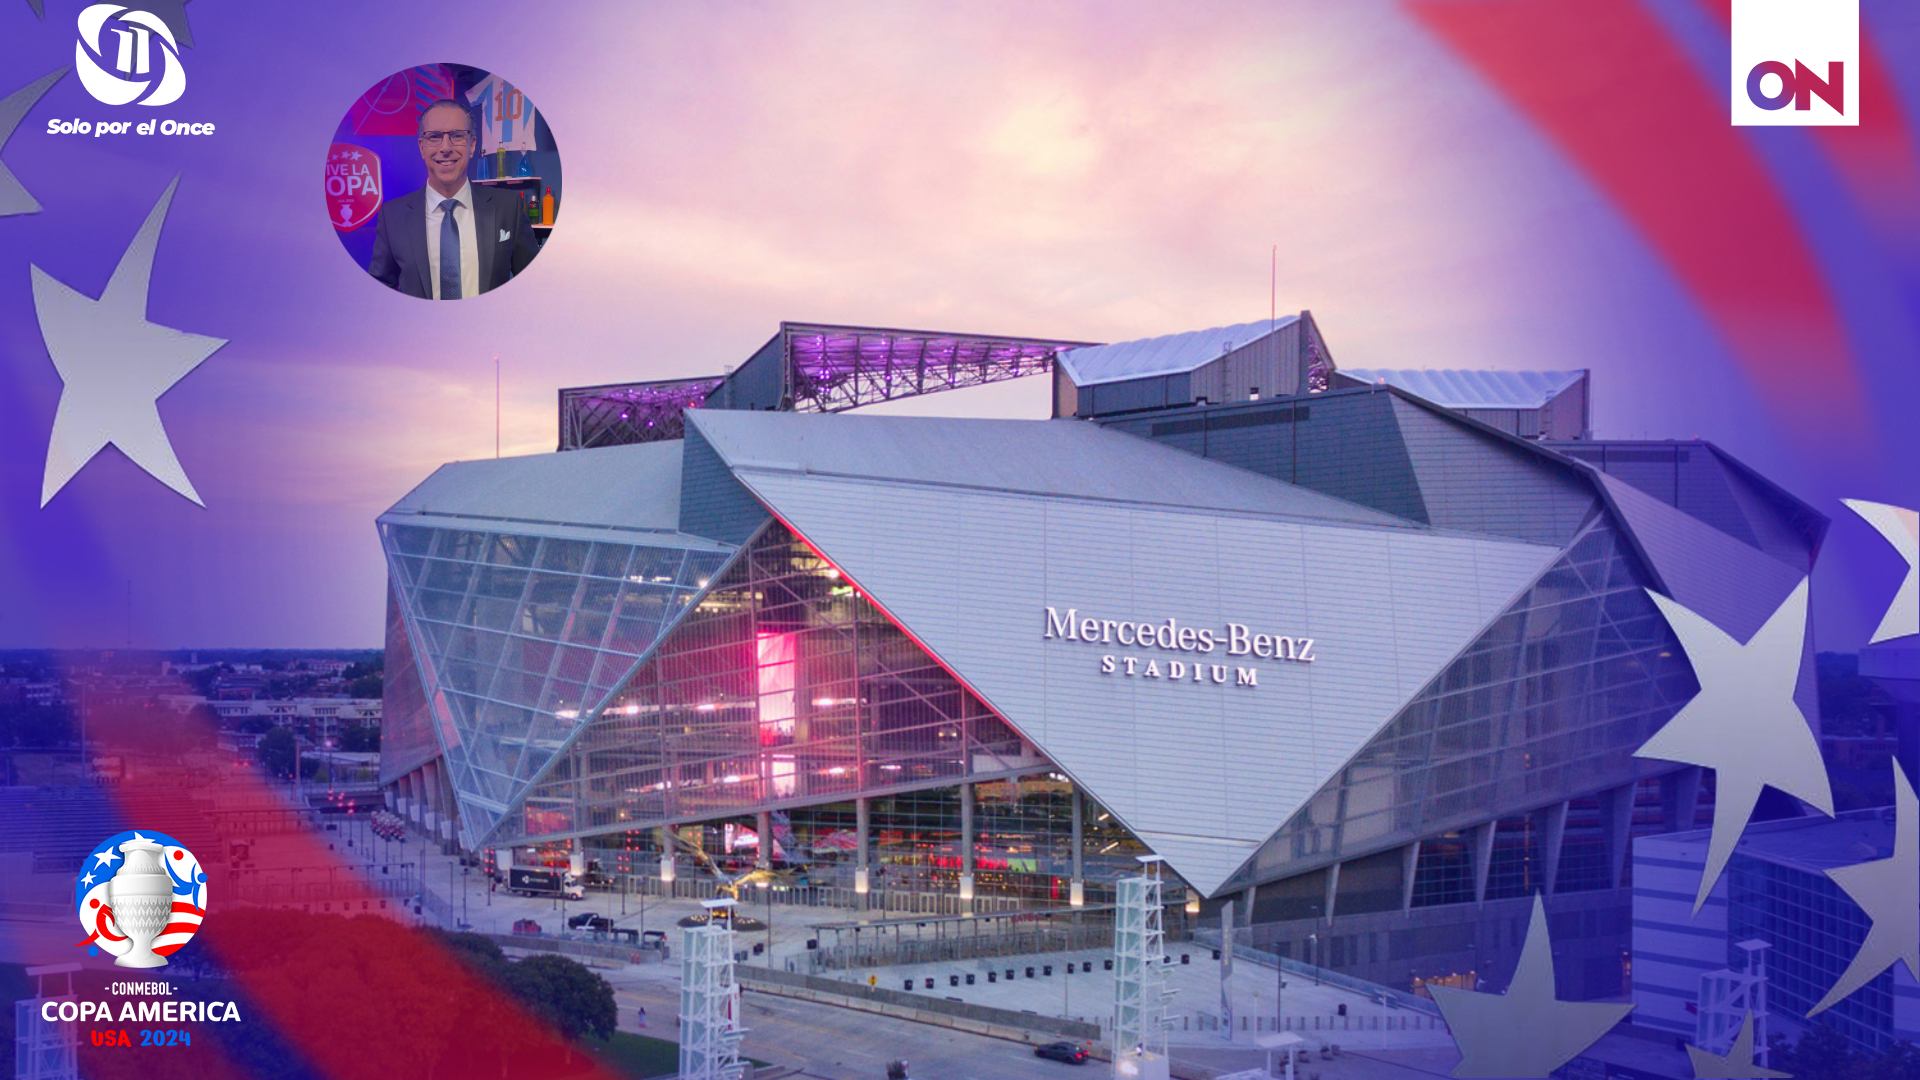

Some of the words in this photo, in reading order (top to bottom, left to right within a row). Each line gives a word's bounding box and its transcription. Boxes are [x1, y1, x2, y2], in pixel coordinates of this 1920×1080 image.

[494, 88, 523, 122] 10
[326, 163, 349, 176] IVE
[352, 163, 370, 176] LA
[326, 175, 379, 197] OPA
[1043, 606, 1316, 662] Mercedes-Benz
[1104, 656, 1259, 687] STADIUM
